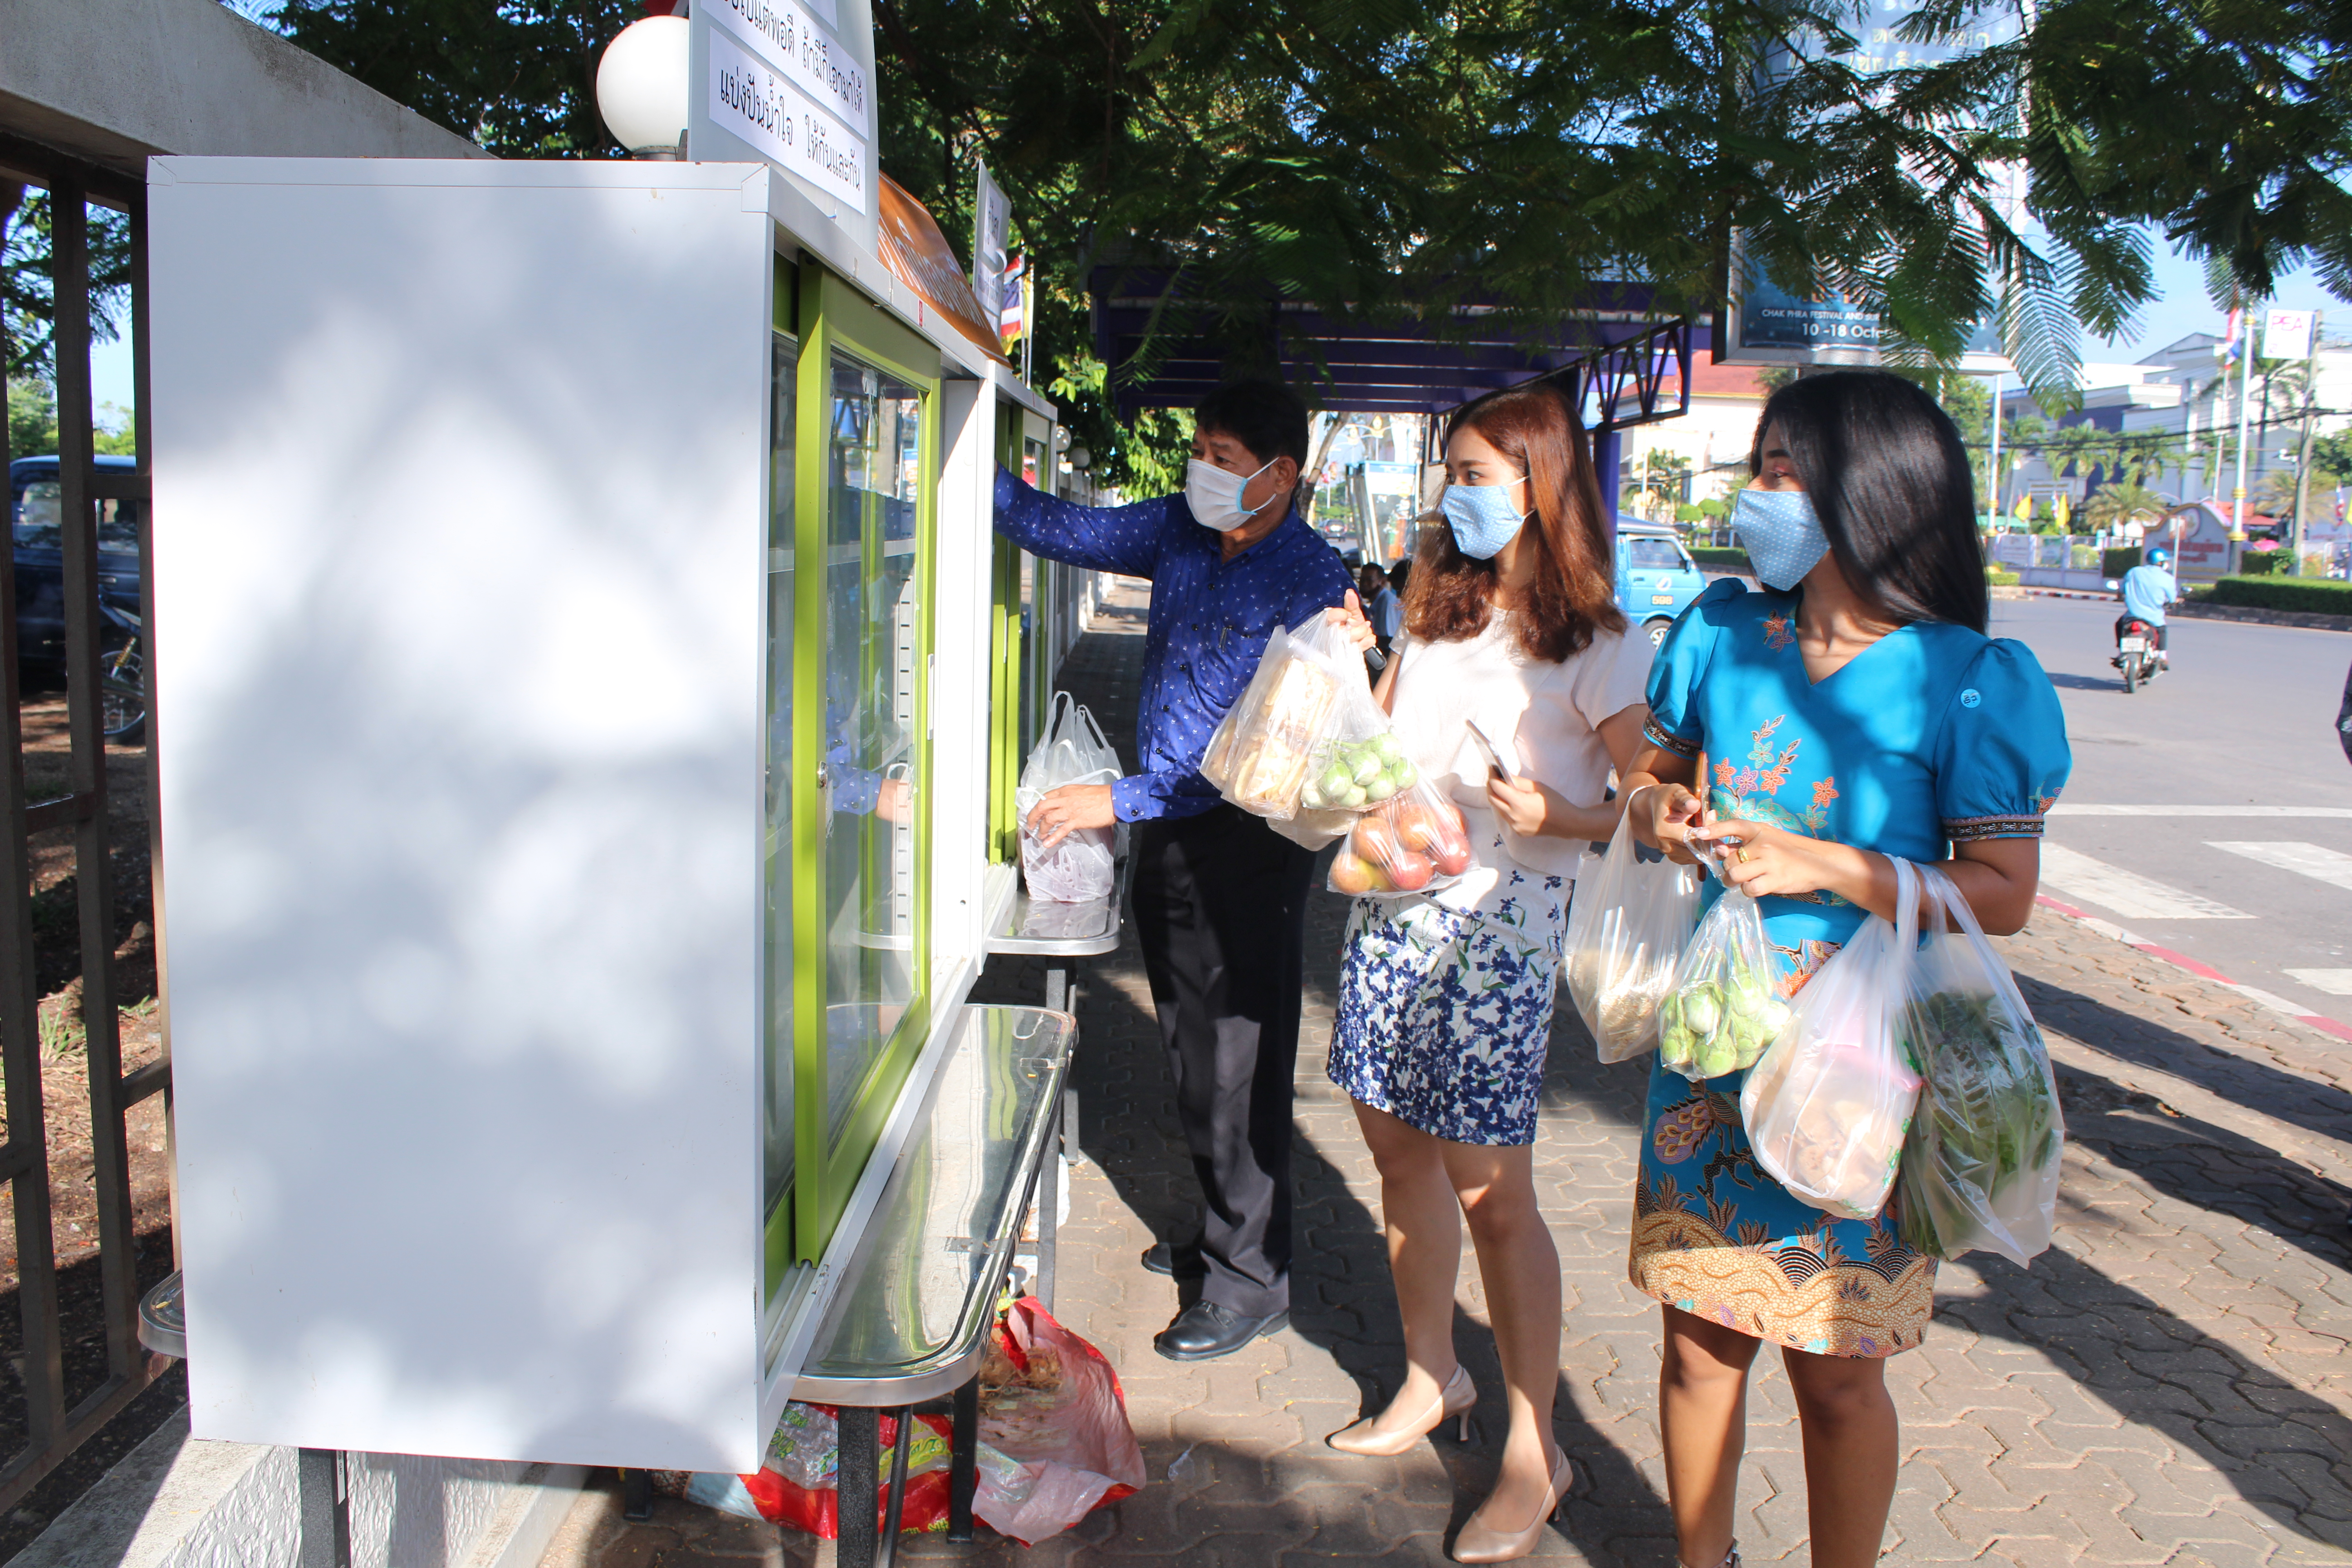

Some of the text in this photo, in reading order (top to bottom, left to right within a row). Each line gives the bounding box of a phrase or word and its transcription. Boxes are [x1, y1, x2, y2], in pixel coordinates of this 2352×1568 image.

[802, 26, 862, 116] ถ้ามีก็เอามาให้
[720, 65, 861, 191] แบ่งปันน้ำใจ ให้กันและกัน
[1761, 309, 1785, 318] CHAK
[1787, 309, 1808, 319] PHRA
[1810, 310, 1843, 320] FESTIVAL
[1844, 311, 1864, 321] AND
[2271, 315, 2303, 331] PEA
[1803, 323, 1819, 336] 10
